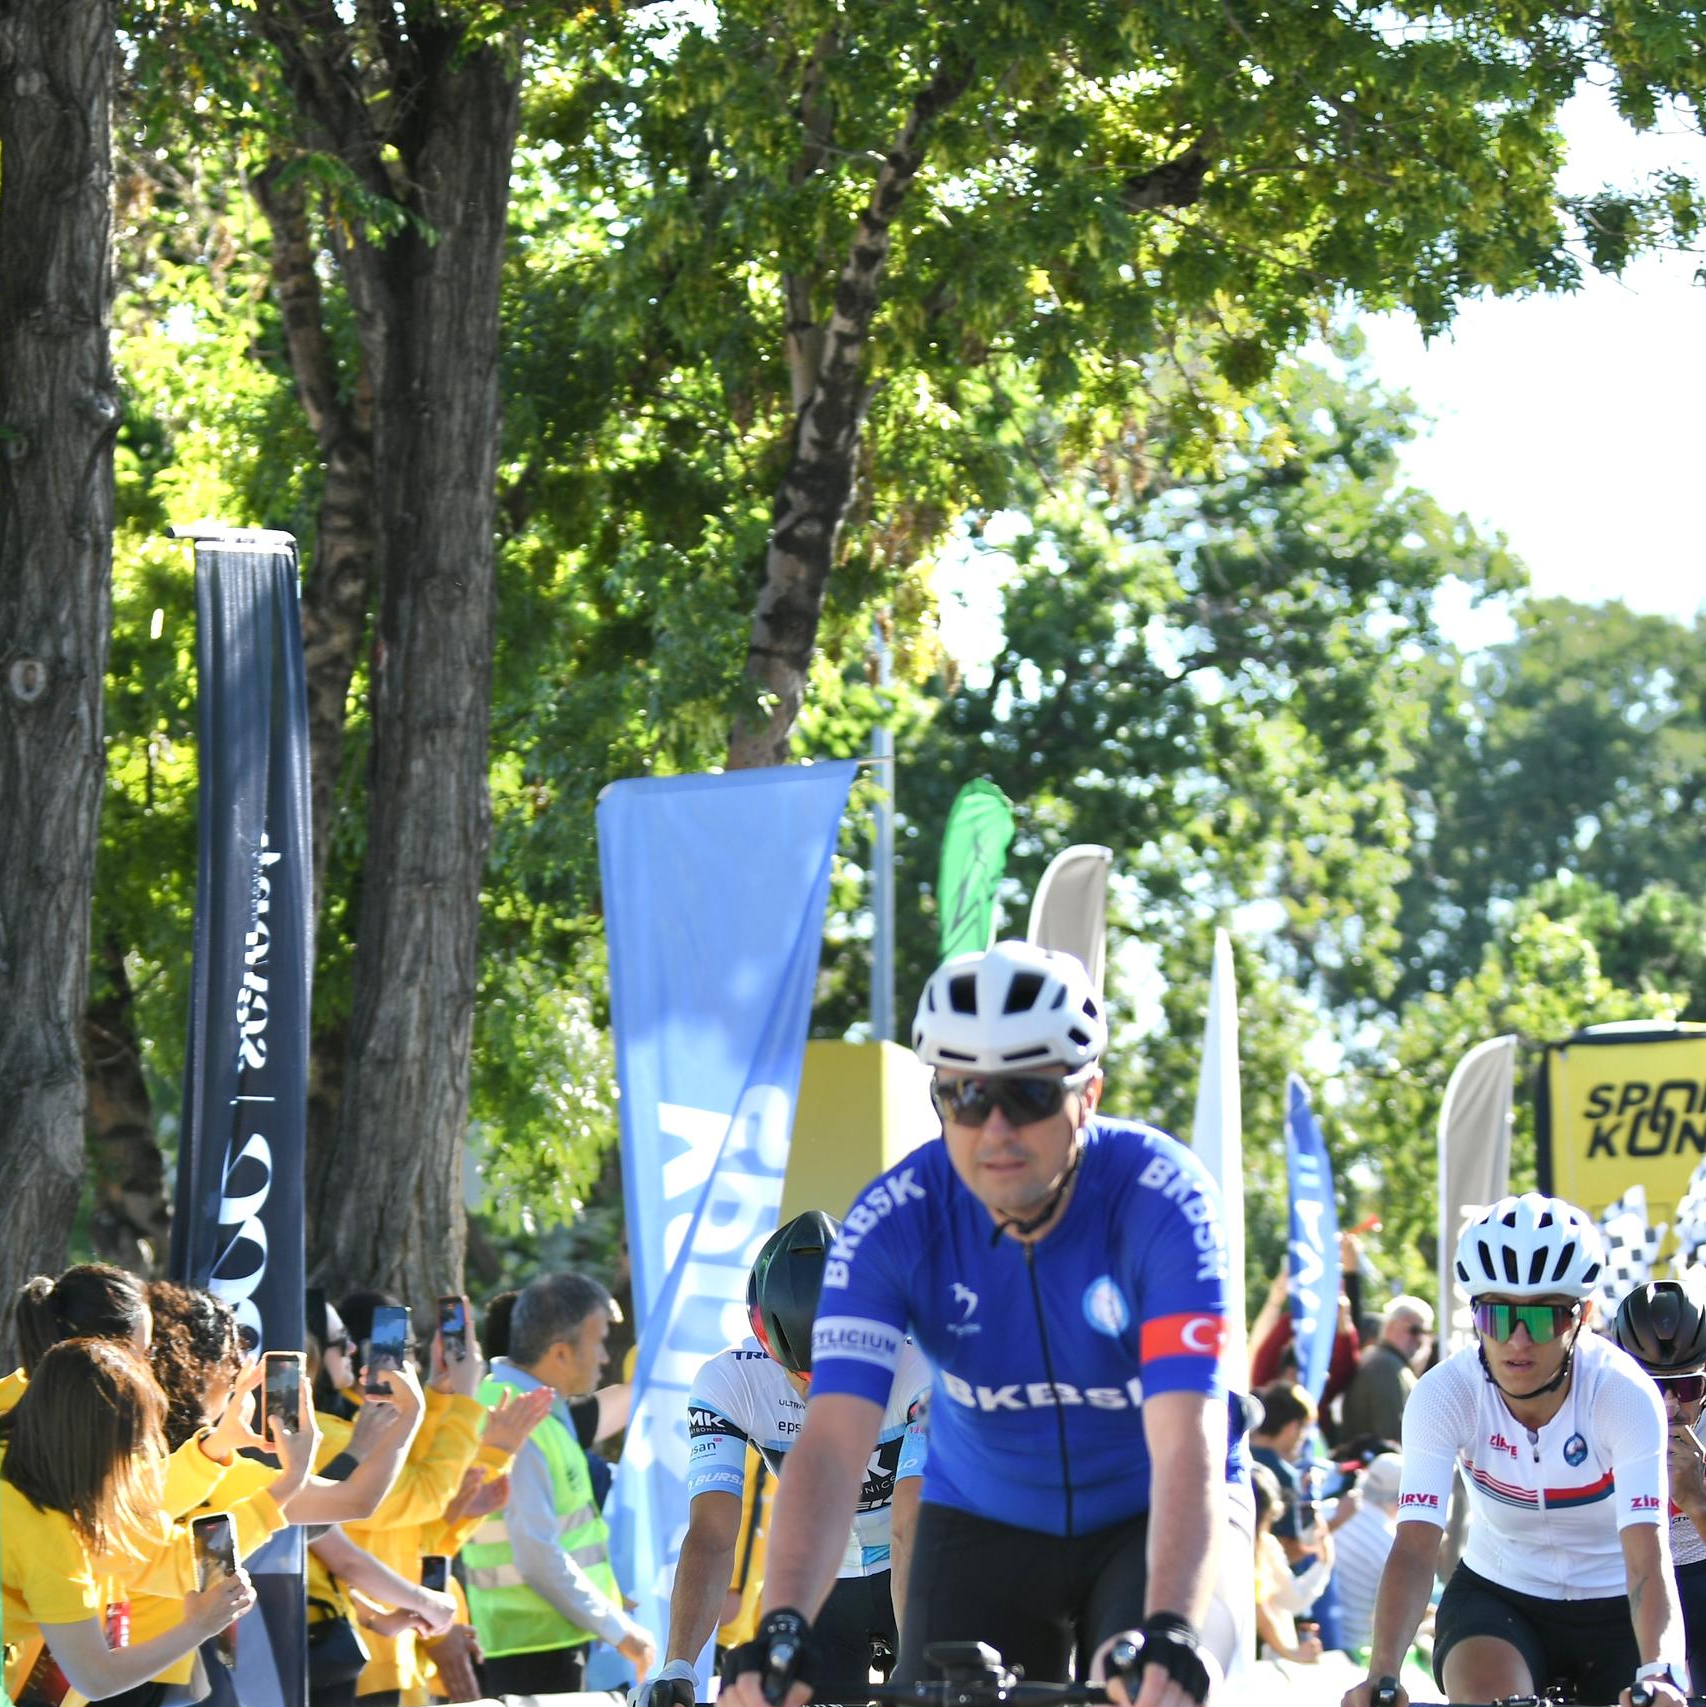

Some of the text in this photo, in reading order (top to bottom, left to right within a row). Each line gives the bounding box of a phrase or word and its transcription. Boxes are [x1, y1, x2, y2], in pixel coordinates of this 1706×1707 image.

[824, 1167, 927, 1290] BKBSK
[778, 1420, 803, 1435] eps
[1631, 1493, 1660, 1509] ZİR
